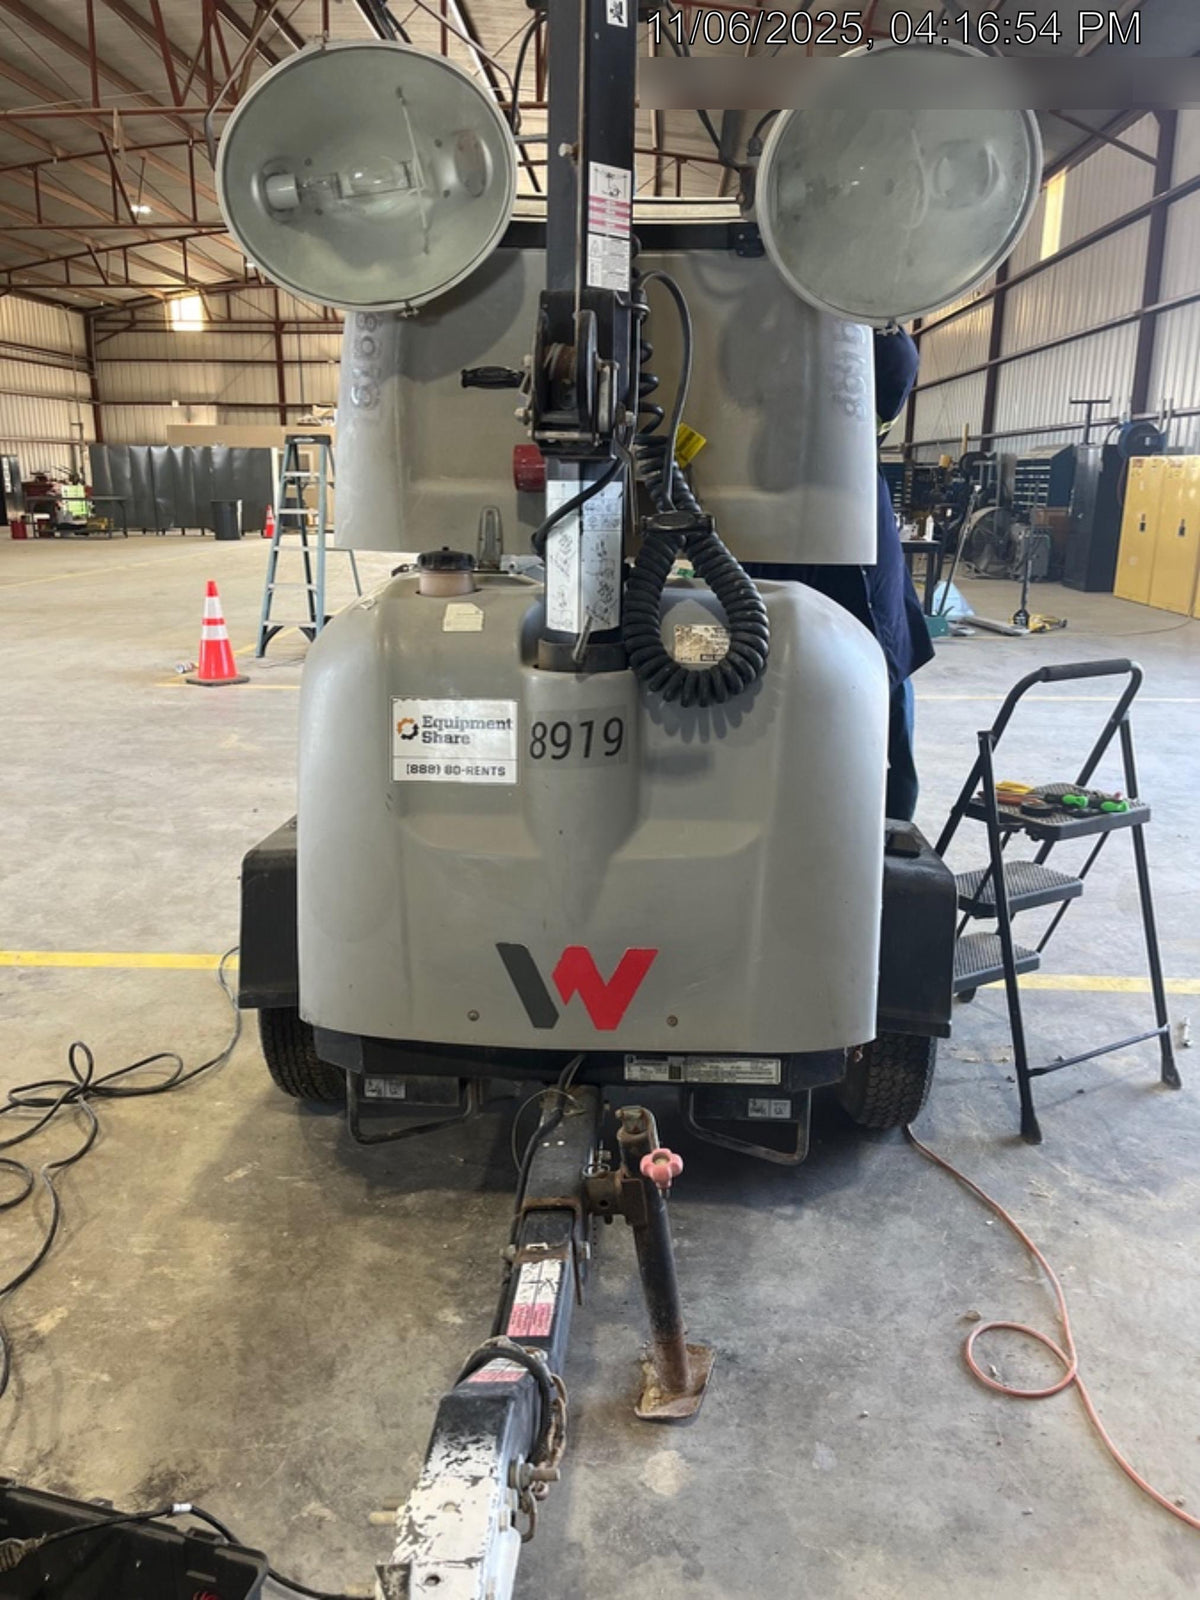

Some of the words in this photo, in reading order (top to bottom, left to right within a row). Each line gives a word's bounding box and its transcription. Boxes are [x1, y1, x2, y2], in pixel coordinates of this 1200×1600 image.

[422, 715, 513, 731] Equipment
[422, 731, 471, 745] Share
[529, 716, 624, 760] 8919
